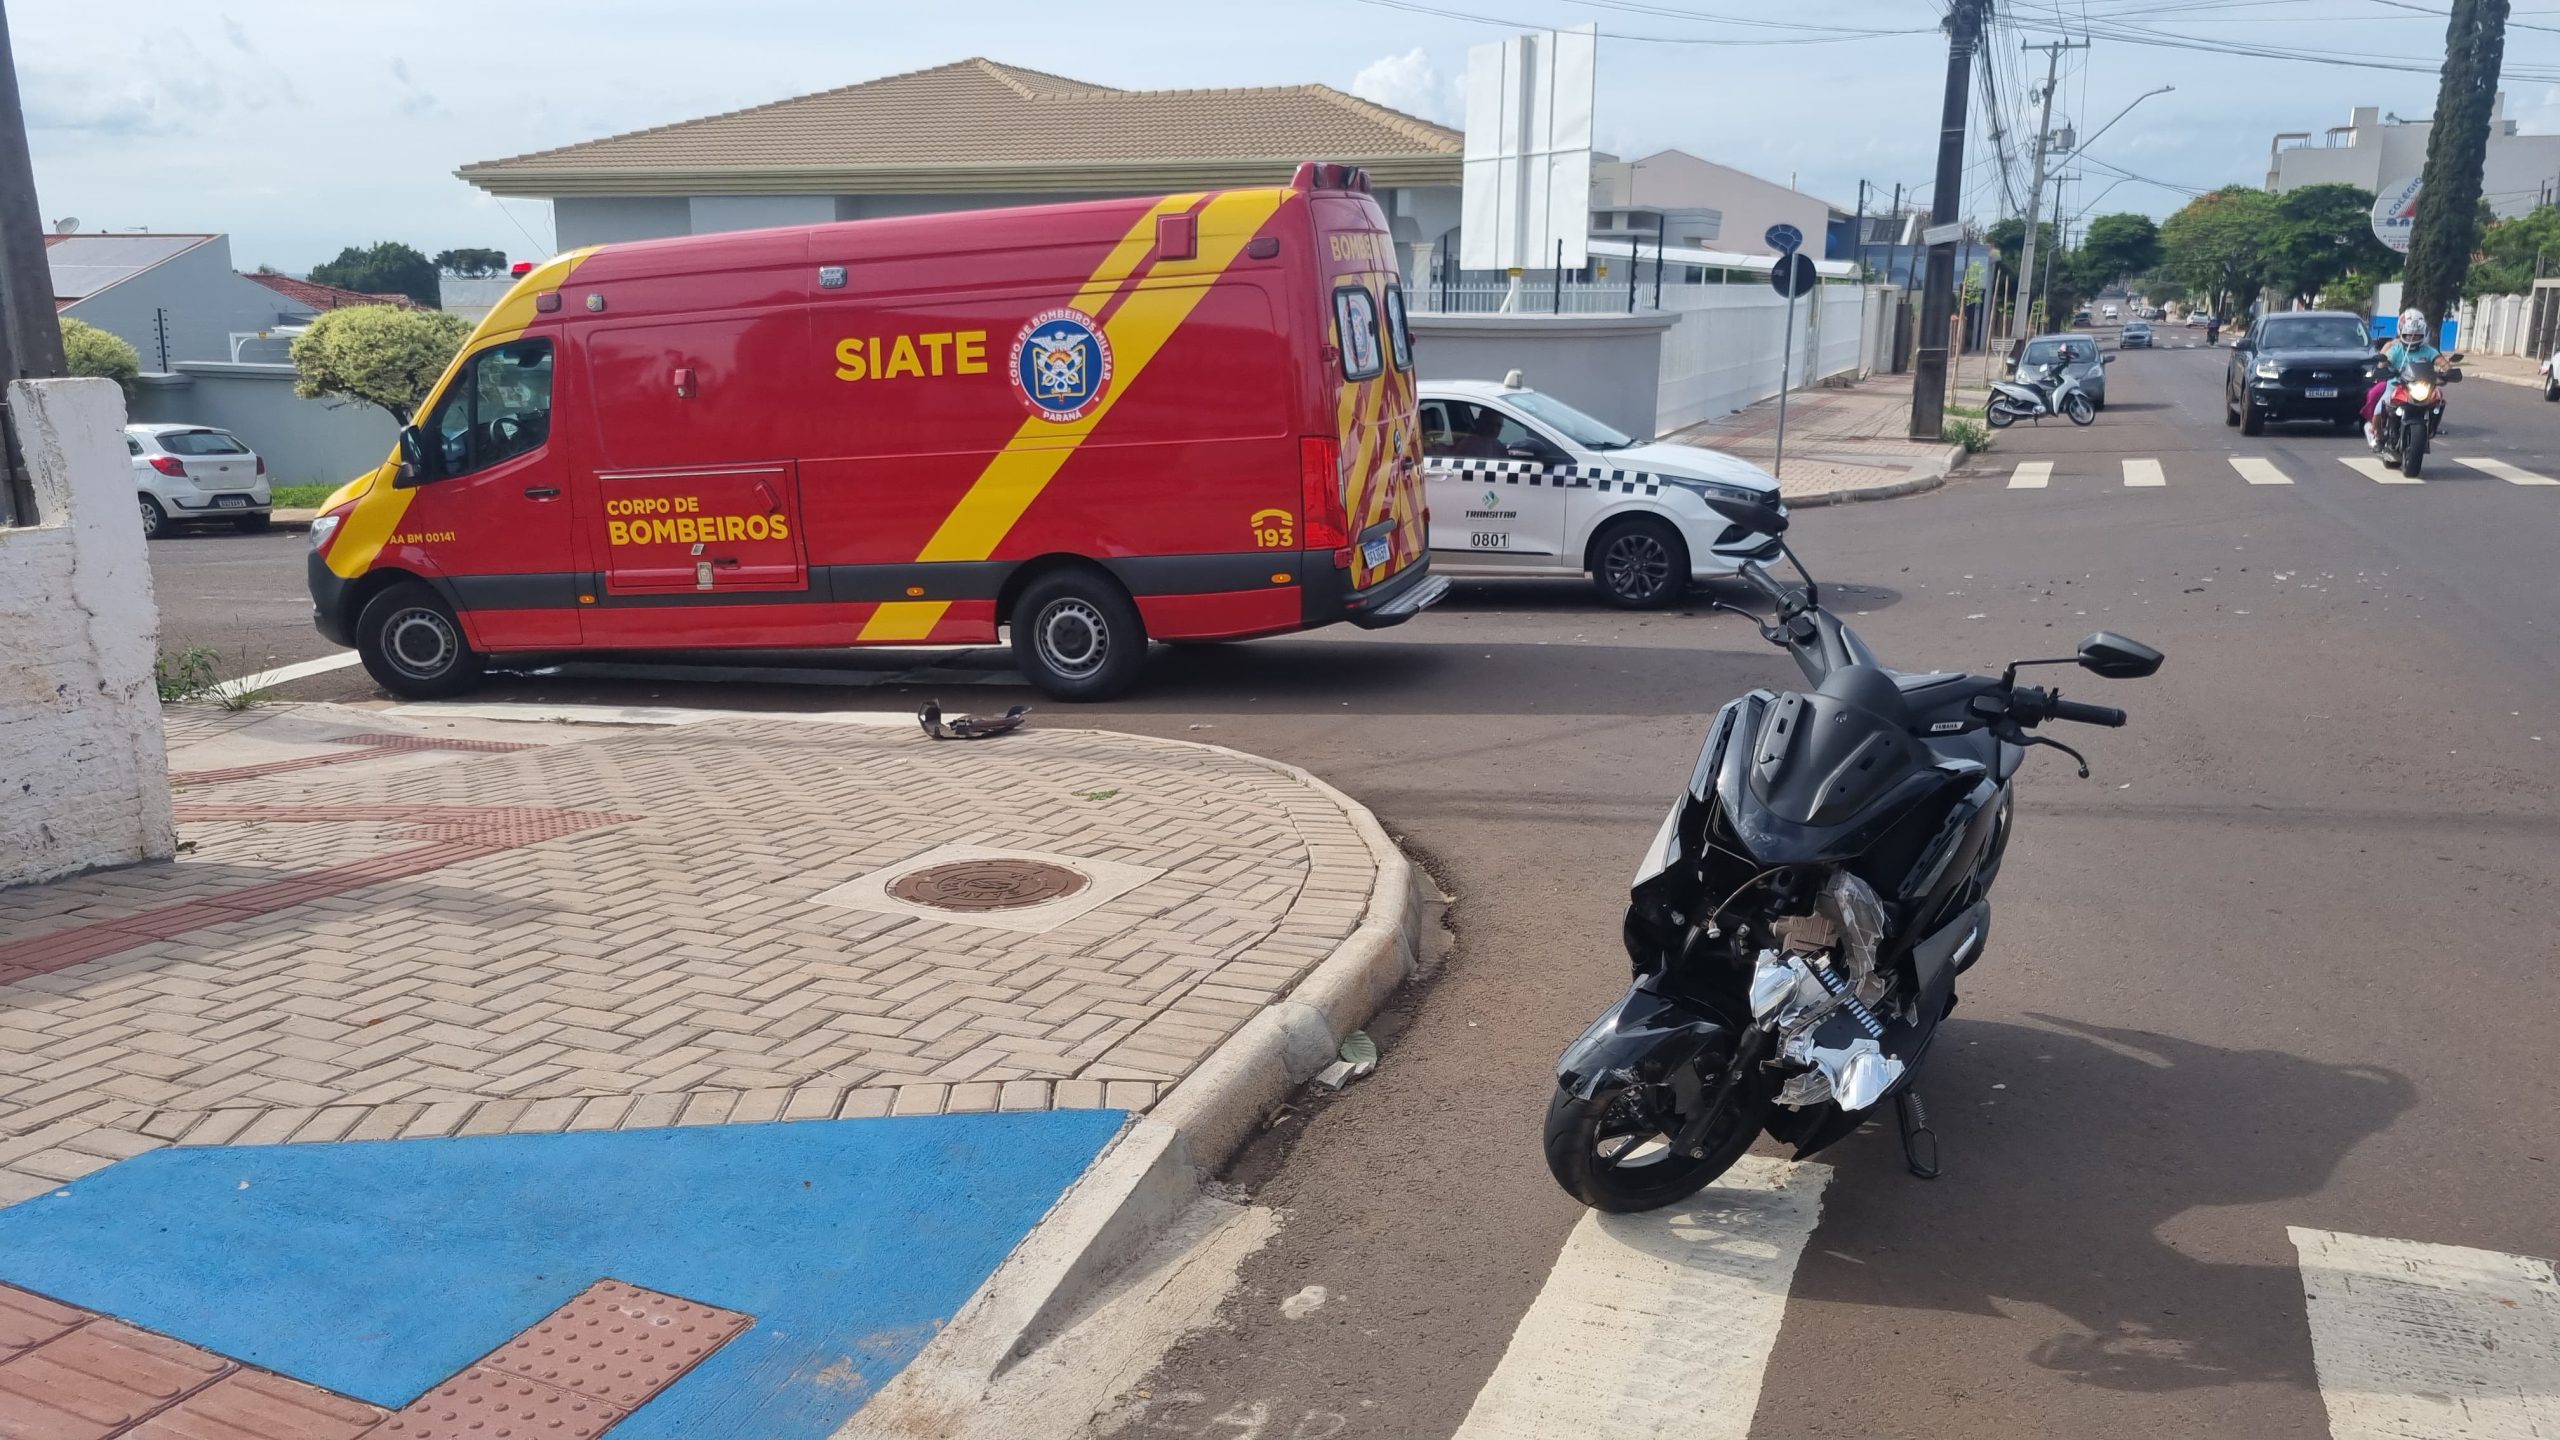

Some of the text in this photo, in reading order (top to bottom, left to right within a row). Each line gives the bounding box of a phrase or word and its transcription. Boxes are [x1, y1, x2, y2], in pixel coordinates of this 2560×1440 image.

[835, 330, 988, 382] SIATE
[1009, 310, 1112, 386] CORPO DE BOMBEIROS MILITAR
[607, 497, 700, 515] CORPO DE
[1465, 510, 1517, 519] TRANSITAR
[389, 531, 456, 545] AA BM 00141
[609, 514, 789, 545] BOMBEIROS
[1254, 528, 1294, 547] 193
[1472, 533, 1507, 547] 0801
